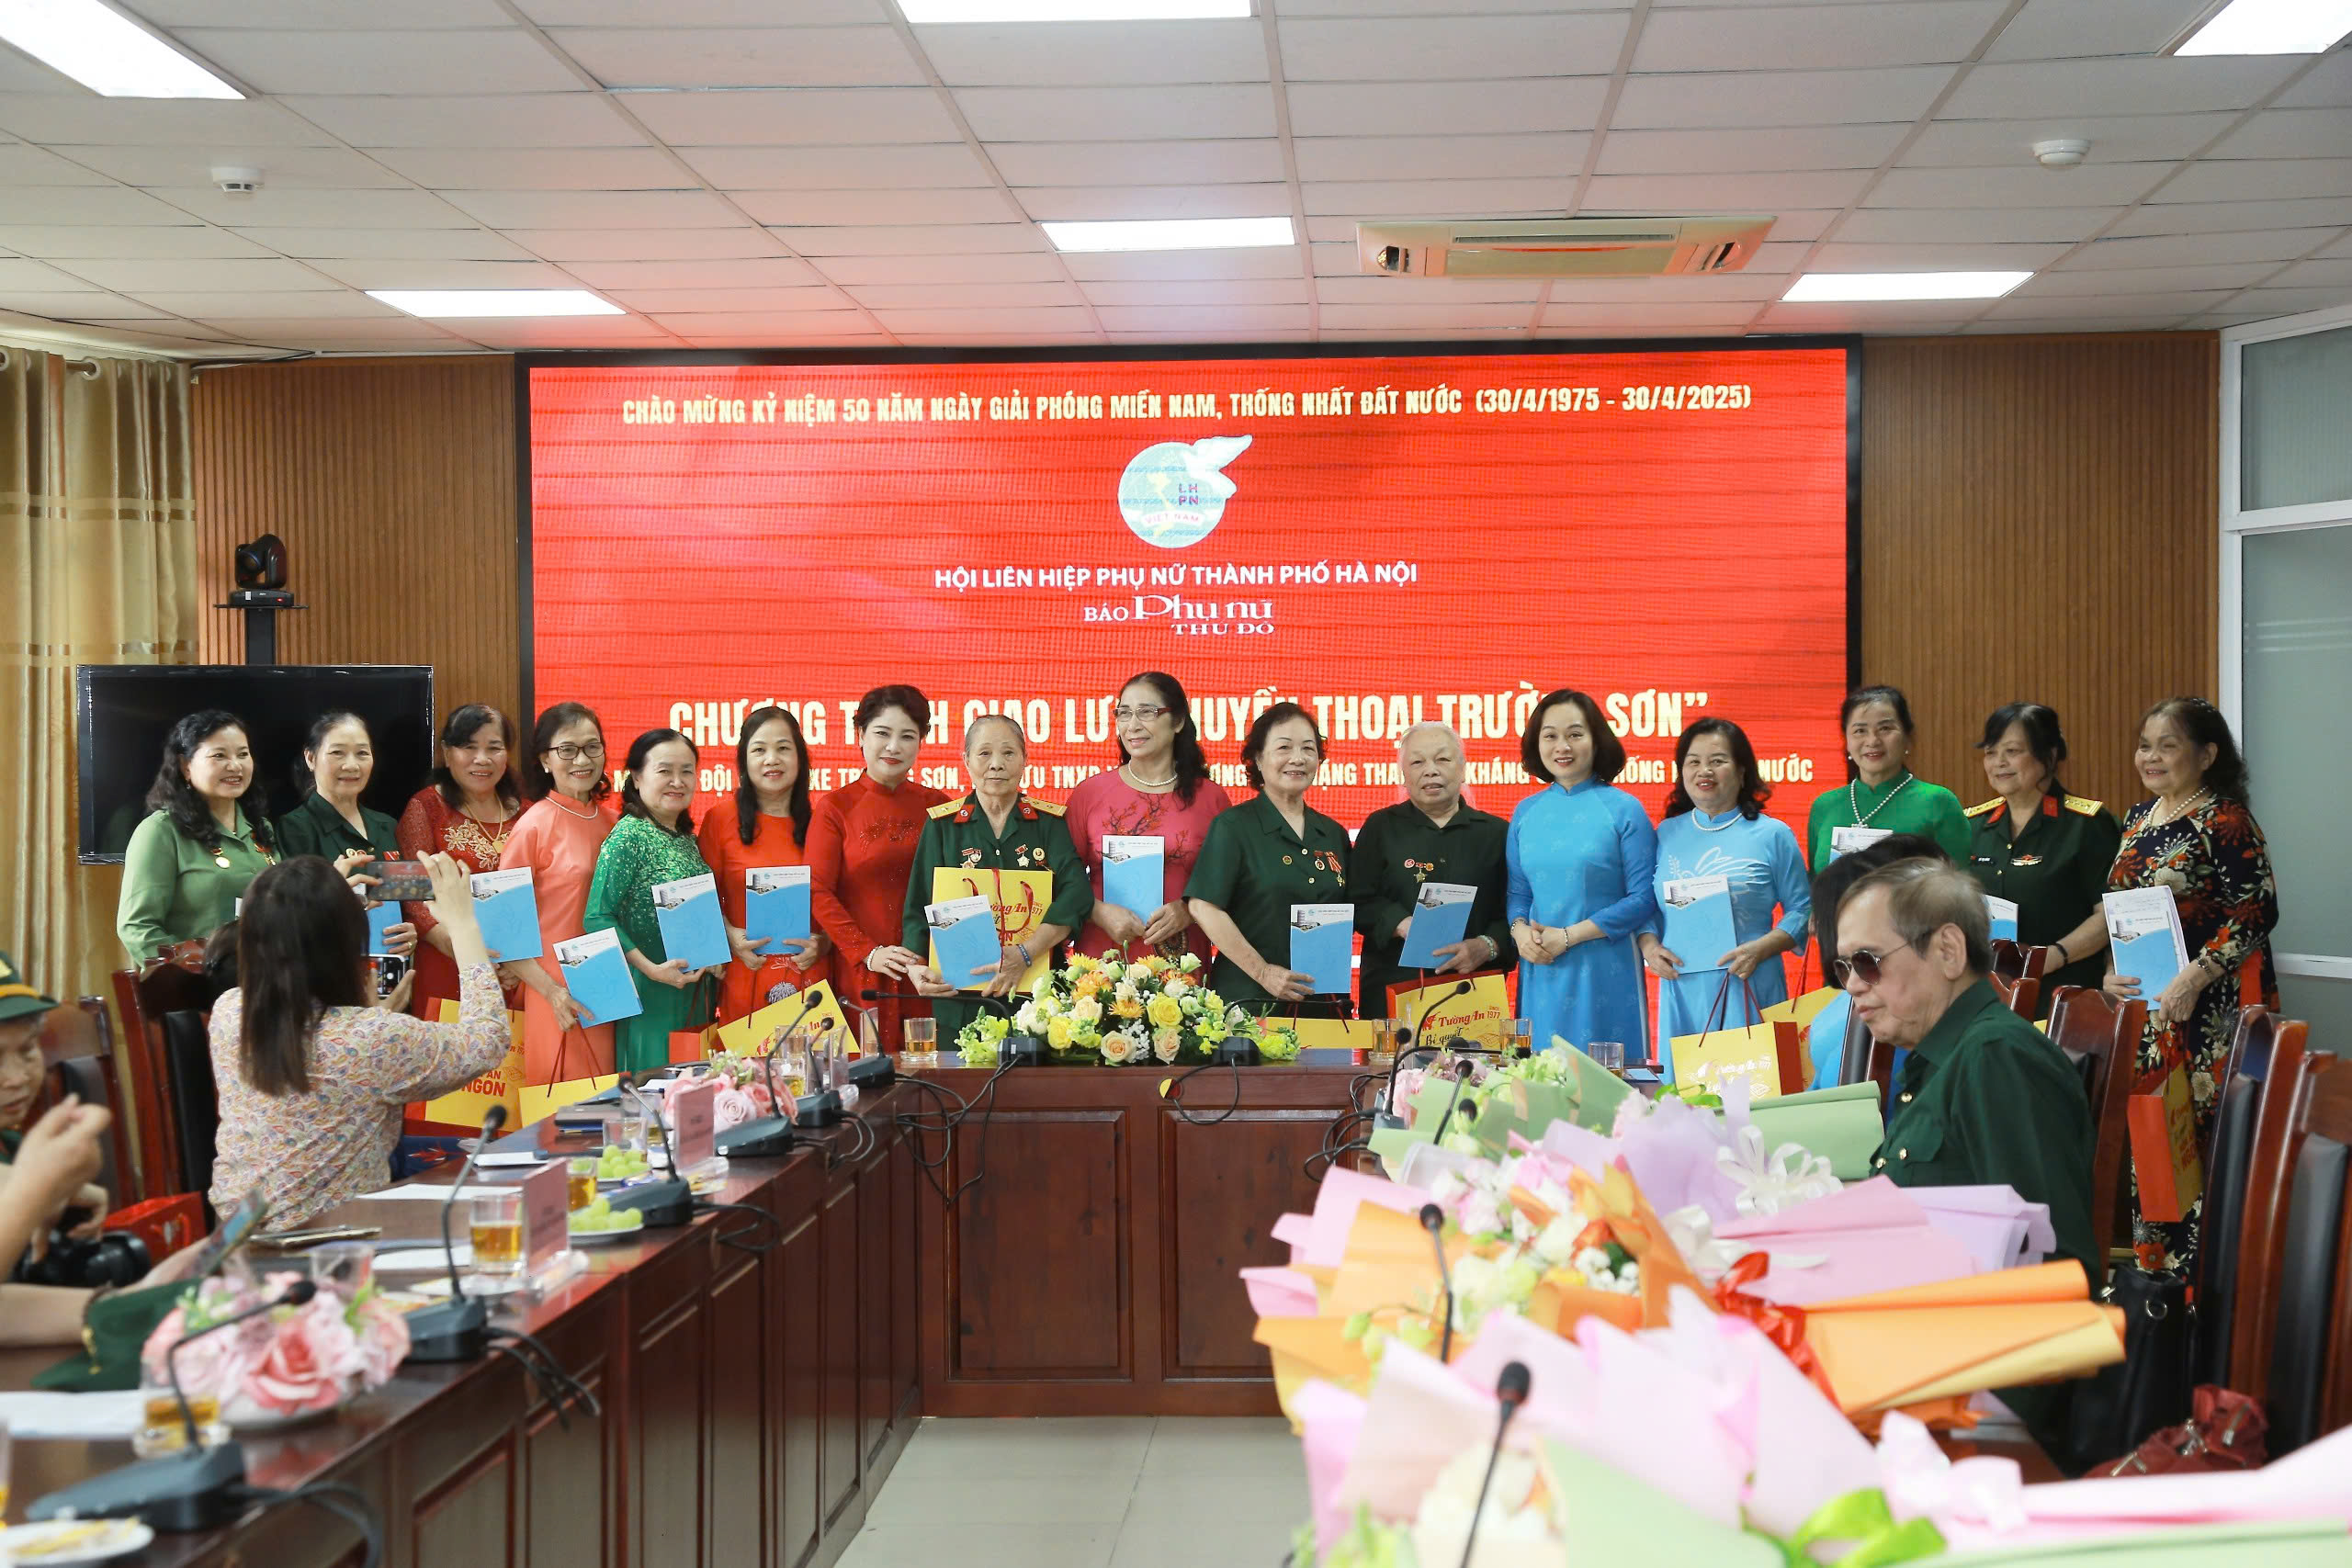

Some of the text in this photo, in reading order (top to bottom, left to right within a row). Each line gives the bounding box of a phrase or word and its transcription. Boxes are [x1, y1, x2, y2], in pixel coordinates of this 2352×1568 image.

[622, 394, 675, 424] CHÀO
[683, 394, 745, 423] MỪNG
[752, 391, 777, 423] KỶ
[784, 393, 835, 427] NIỆM
[842, 398, 870, 423] 50
[876, 392, 923, 423] NĂM
[930, 391, 982, 422] NGÀY
[989, 389, 1029, 421] GIẢI
[1035, 389, 1103, 420] PHÓNG
[1110, 389, 1162, 419] MIỀN
[1168, 393, 1223, 420] NAM,
[1229, 387, 1295, 417] THỐNG
[1301, 386, 1355, 416] NHẤT
[1359, 384, 1400, 415] ĐẤT
[1405, 383, 1463, 413] NƯỚC
[1475, 387, 1600, 413] (30/4/1975
[1621, 384, 1752, 411] 30/4/2025)
[934, 559, 1418, 592] HỘI LIÊN HIỆP PHỤ NỮ THÀNH PHỐ HÀ NỘI
[1084, 603, 1129, 622] BÁO
[670, 698, 826, 746] CHƯG
[1065, 695, 1121, 743] LƯ
[1190, 685, 1298, 741] UYỀ
[1436, 681, 1548, 739] TRƯỜ
[699, 763, 732, 797] ĐỘI
[1363, 762, 1406, 786] THA
[1464, 756, 1531, 784] KHÁNG
[1612, 755, 1666, 784] ỐNG
[1758, 753, 1814, 783] NƯỚC
